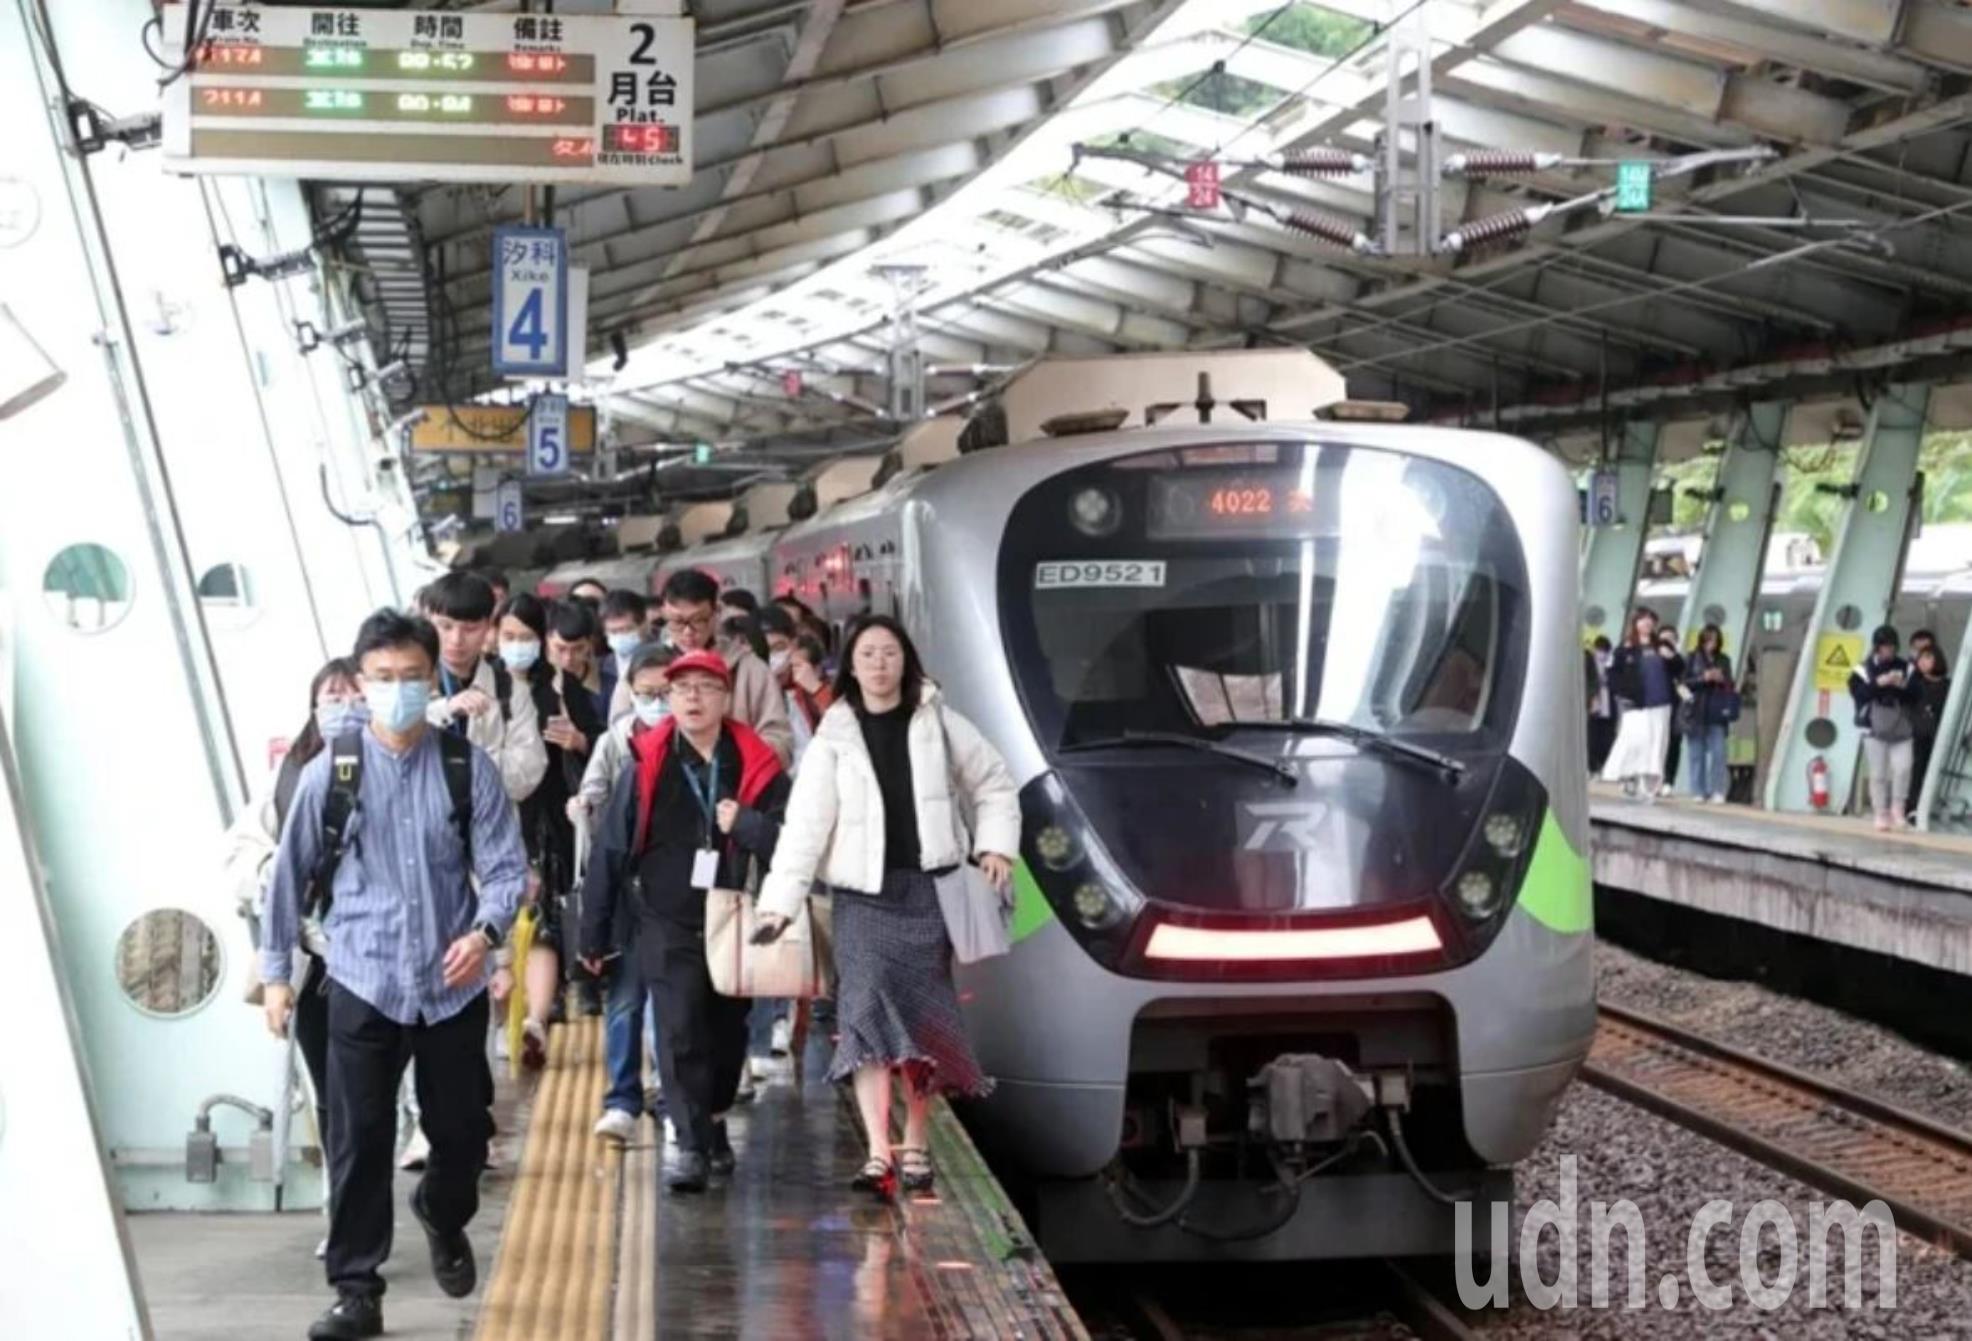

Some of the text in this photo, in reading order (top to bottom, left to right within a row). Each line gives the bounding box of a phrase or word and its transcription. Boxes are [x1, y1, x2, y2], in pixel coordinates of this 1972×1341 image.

[213, 9, 261, 32] 車次
[311, 12, 360, 36] 開往
[414, 15, 464, 39] 時間
[513, 18, 563, 41] 備註
[629, 23, 656, 65] 2
[608, 70, 677, 106] 月台
[503, 240, 556, 267] 汐科
[508, 287, 548, 360] 4
[538, 427, 560, 469] 5
[1211, 488, 1272, 514] 4022
[503, 502, 518, 529] 6
[1039, 563, 1162, 585] ED9521
